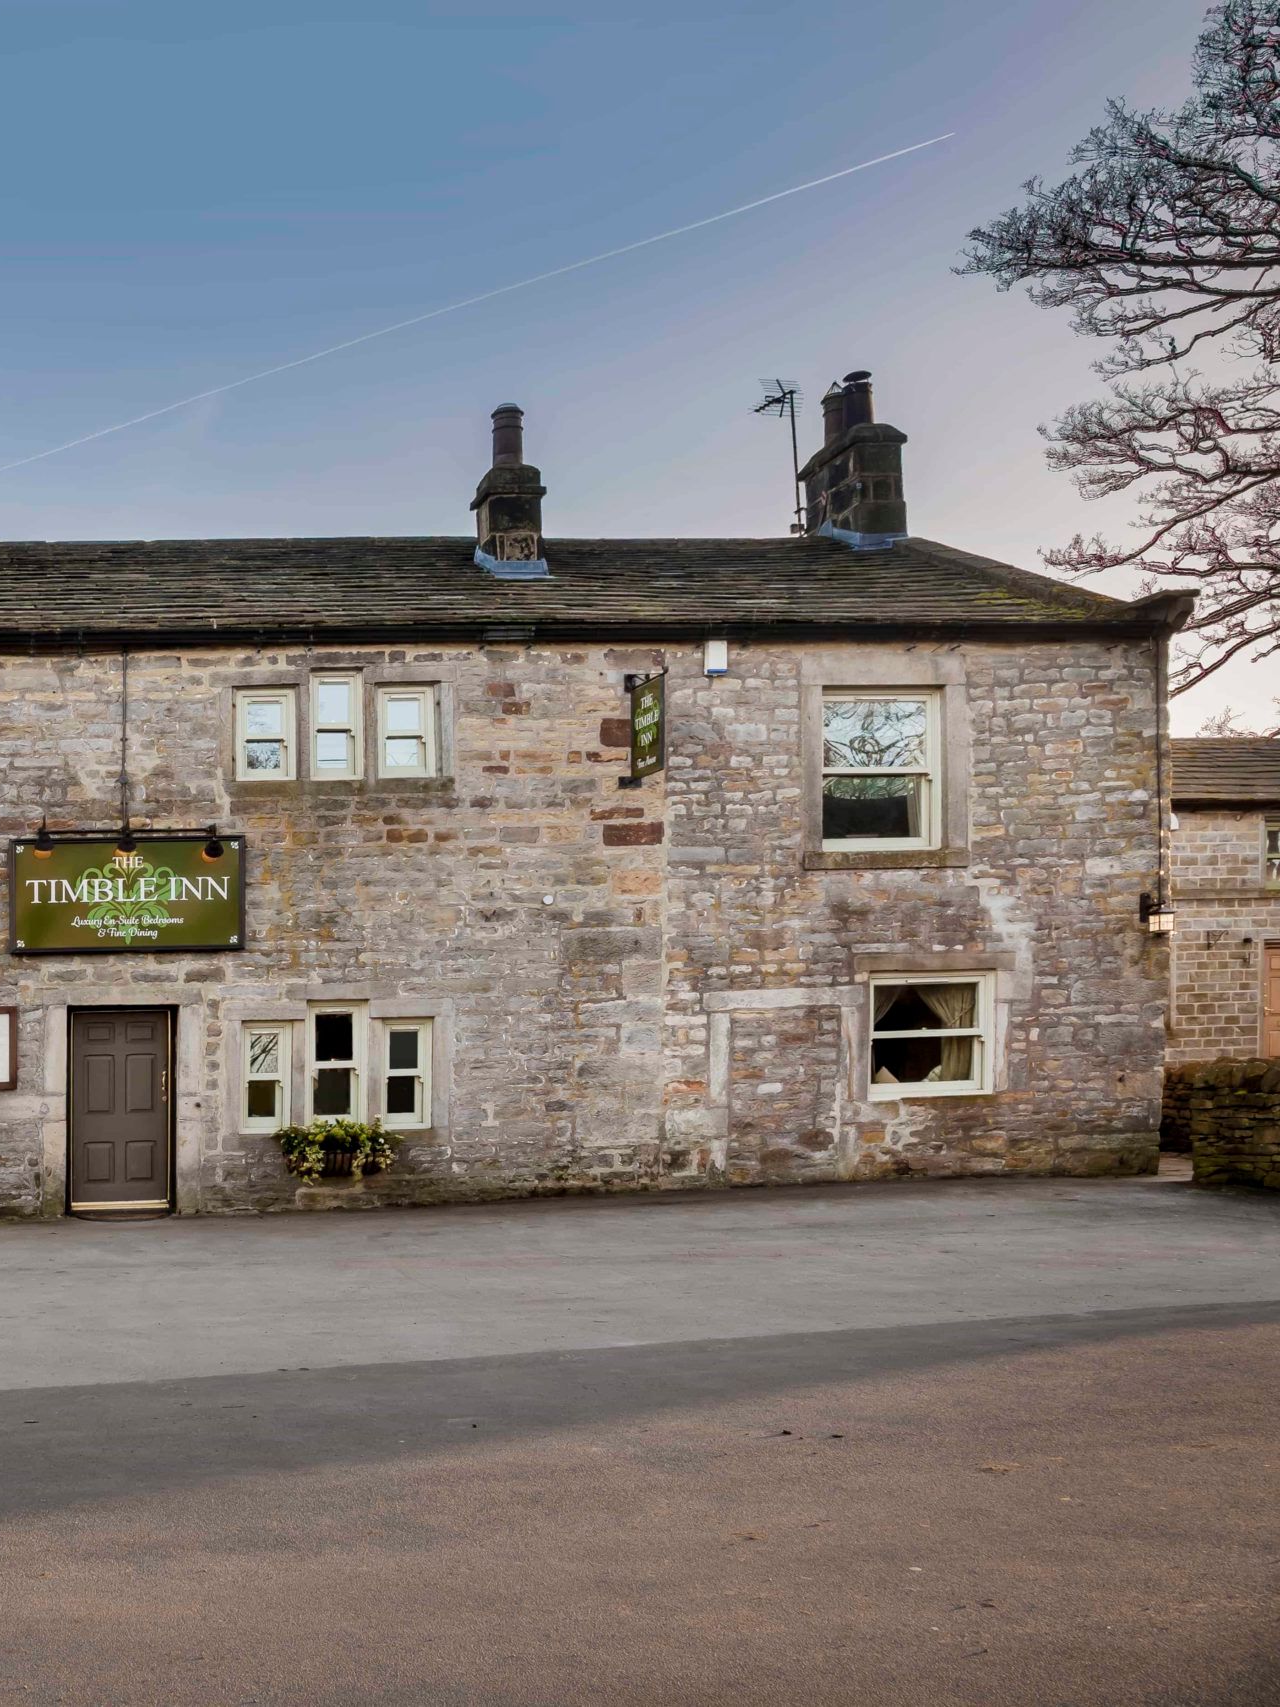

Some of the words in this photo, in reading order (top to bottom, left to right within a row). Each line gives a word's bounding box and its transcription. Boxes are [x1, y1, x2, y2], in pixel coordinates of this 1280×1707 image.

[641, 694, 654, 709] THE
[635, 710, 659, 730] TIMBLE
[641, 731, 653, 746] INN
[112, 856, 144, 869] THE
[25, 877, 158, 904] TIMBLE
[168, 876, 231, 901] INN
[71, 916, 103, 928] Luxury
[103, 915, 140, 926] En-Suite
[141, 914, 184, 925] Bedrooms
[97, 928, 106, 938] &
[106, 928, 126, 937] Fine
[128, 927, 158, 940] Dining
